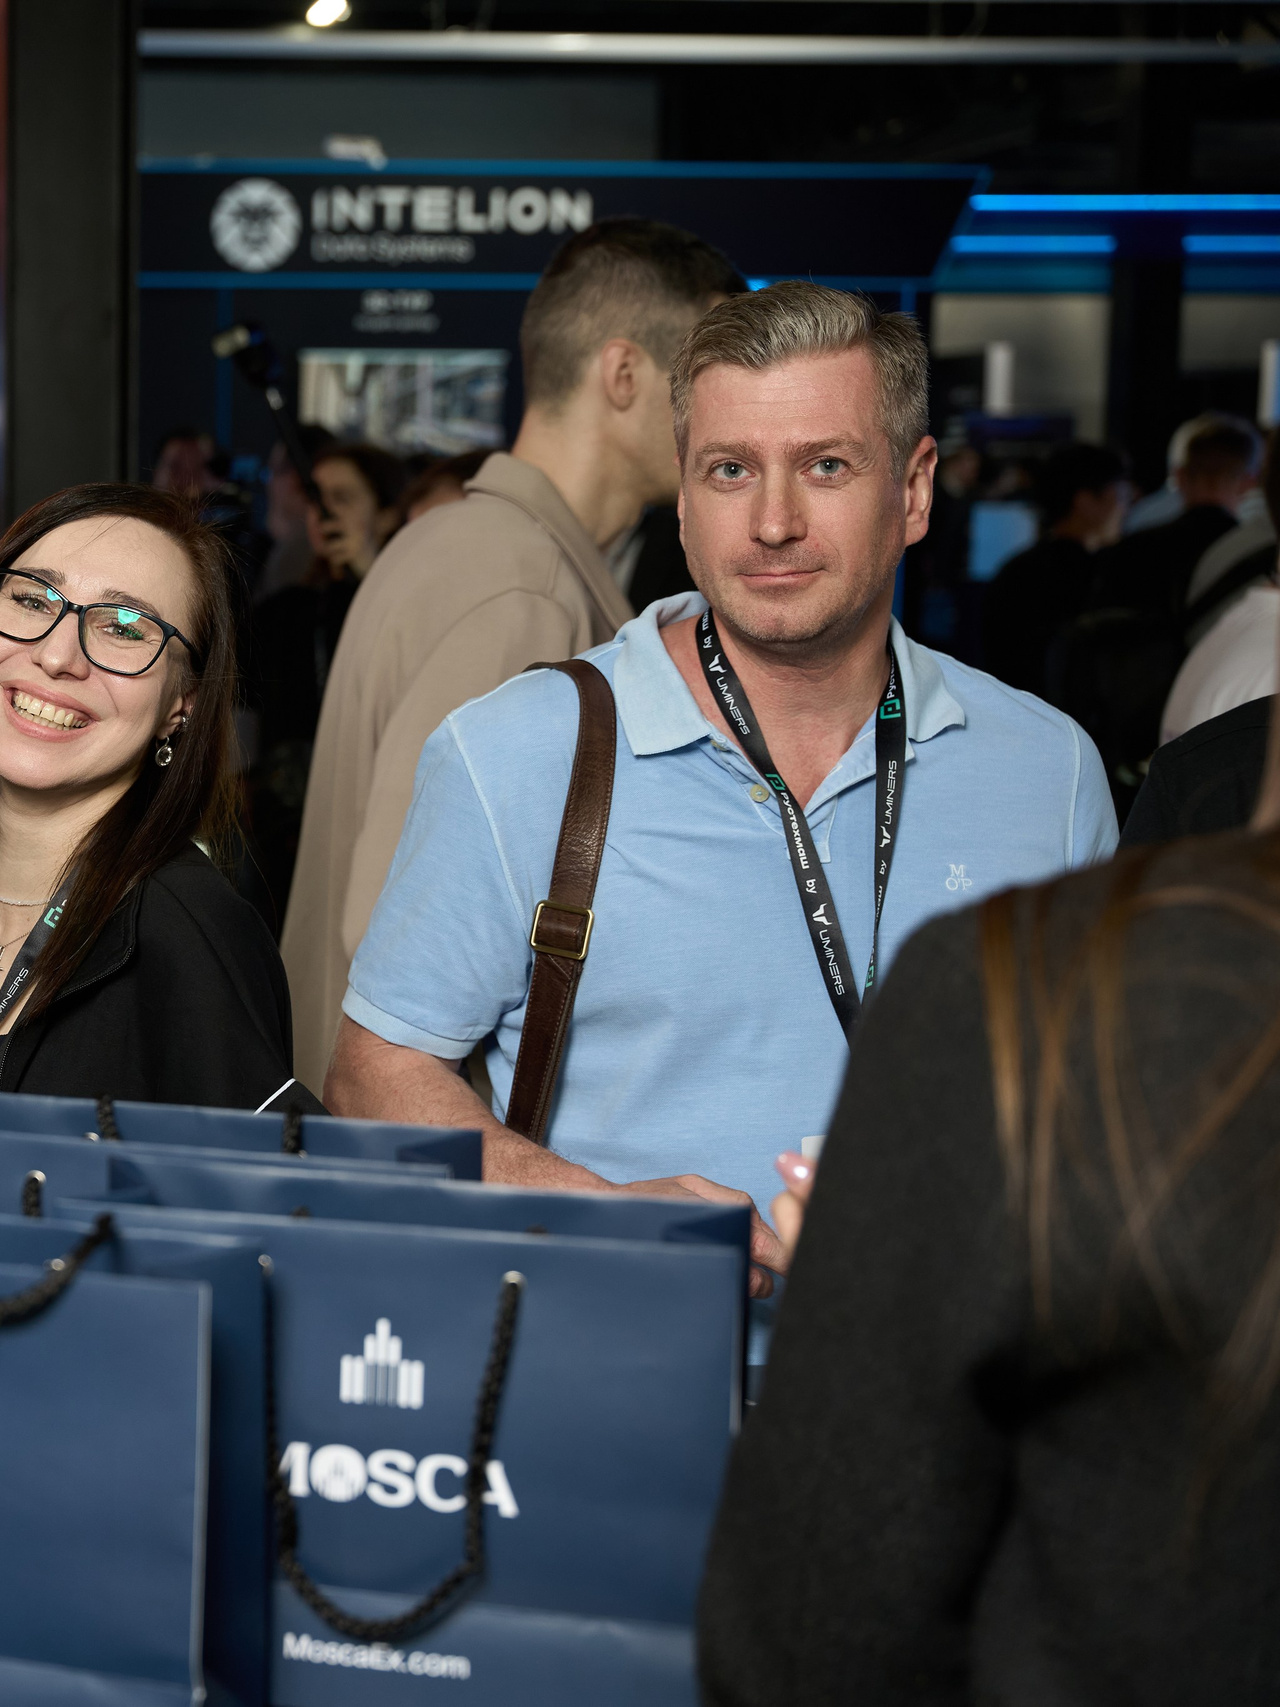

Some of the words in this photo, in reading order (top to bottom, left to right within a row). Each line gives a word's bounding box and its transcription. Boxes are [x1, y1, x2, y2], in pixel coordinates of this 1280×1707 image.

[311, 186, 593, 234] INTELION
[716, 676, 751, 735] UMINERS
[884, 760, 897, 825] UMINERS
[780, 792, 809, 870] Рустехмаш
[806, 878, 817, 894] by
[819, 929, 845, 996] UMINERS
